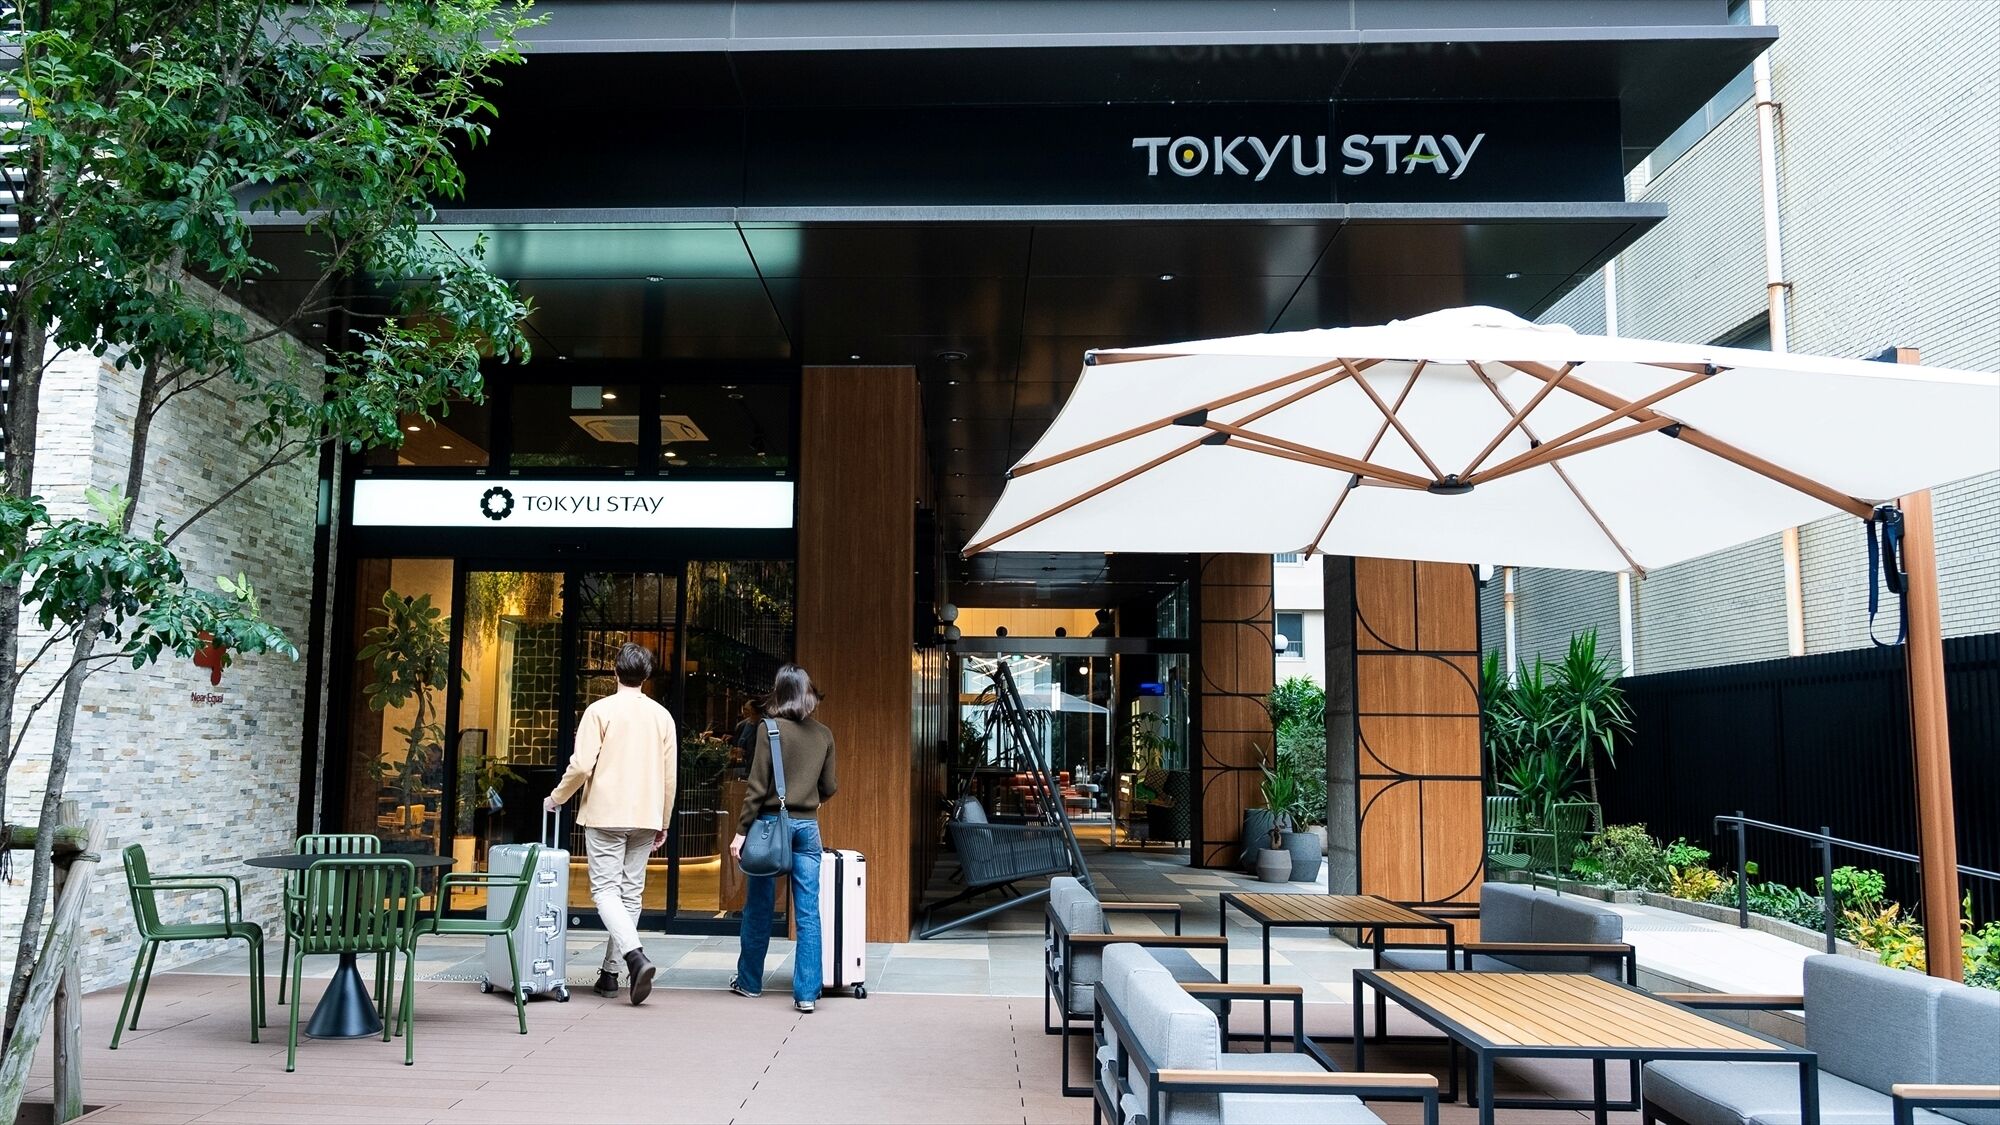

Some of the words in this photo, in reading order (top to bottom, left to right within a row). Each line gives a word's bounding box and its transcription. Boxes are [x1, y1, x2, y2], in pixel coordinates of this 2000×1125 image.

[1131, 134, 1327, 182] TOKYU
[1341, 133, 1487, 181] STAY
[522, 495, 600, 515] TOKYU
[607, 495, 665, 515] STAY
